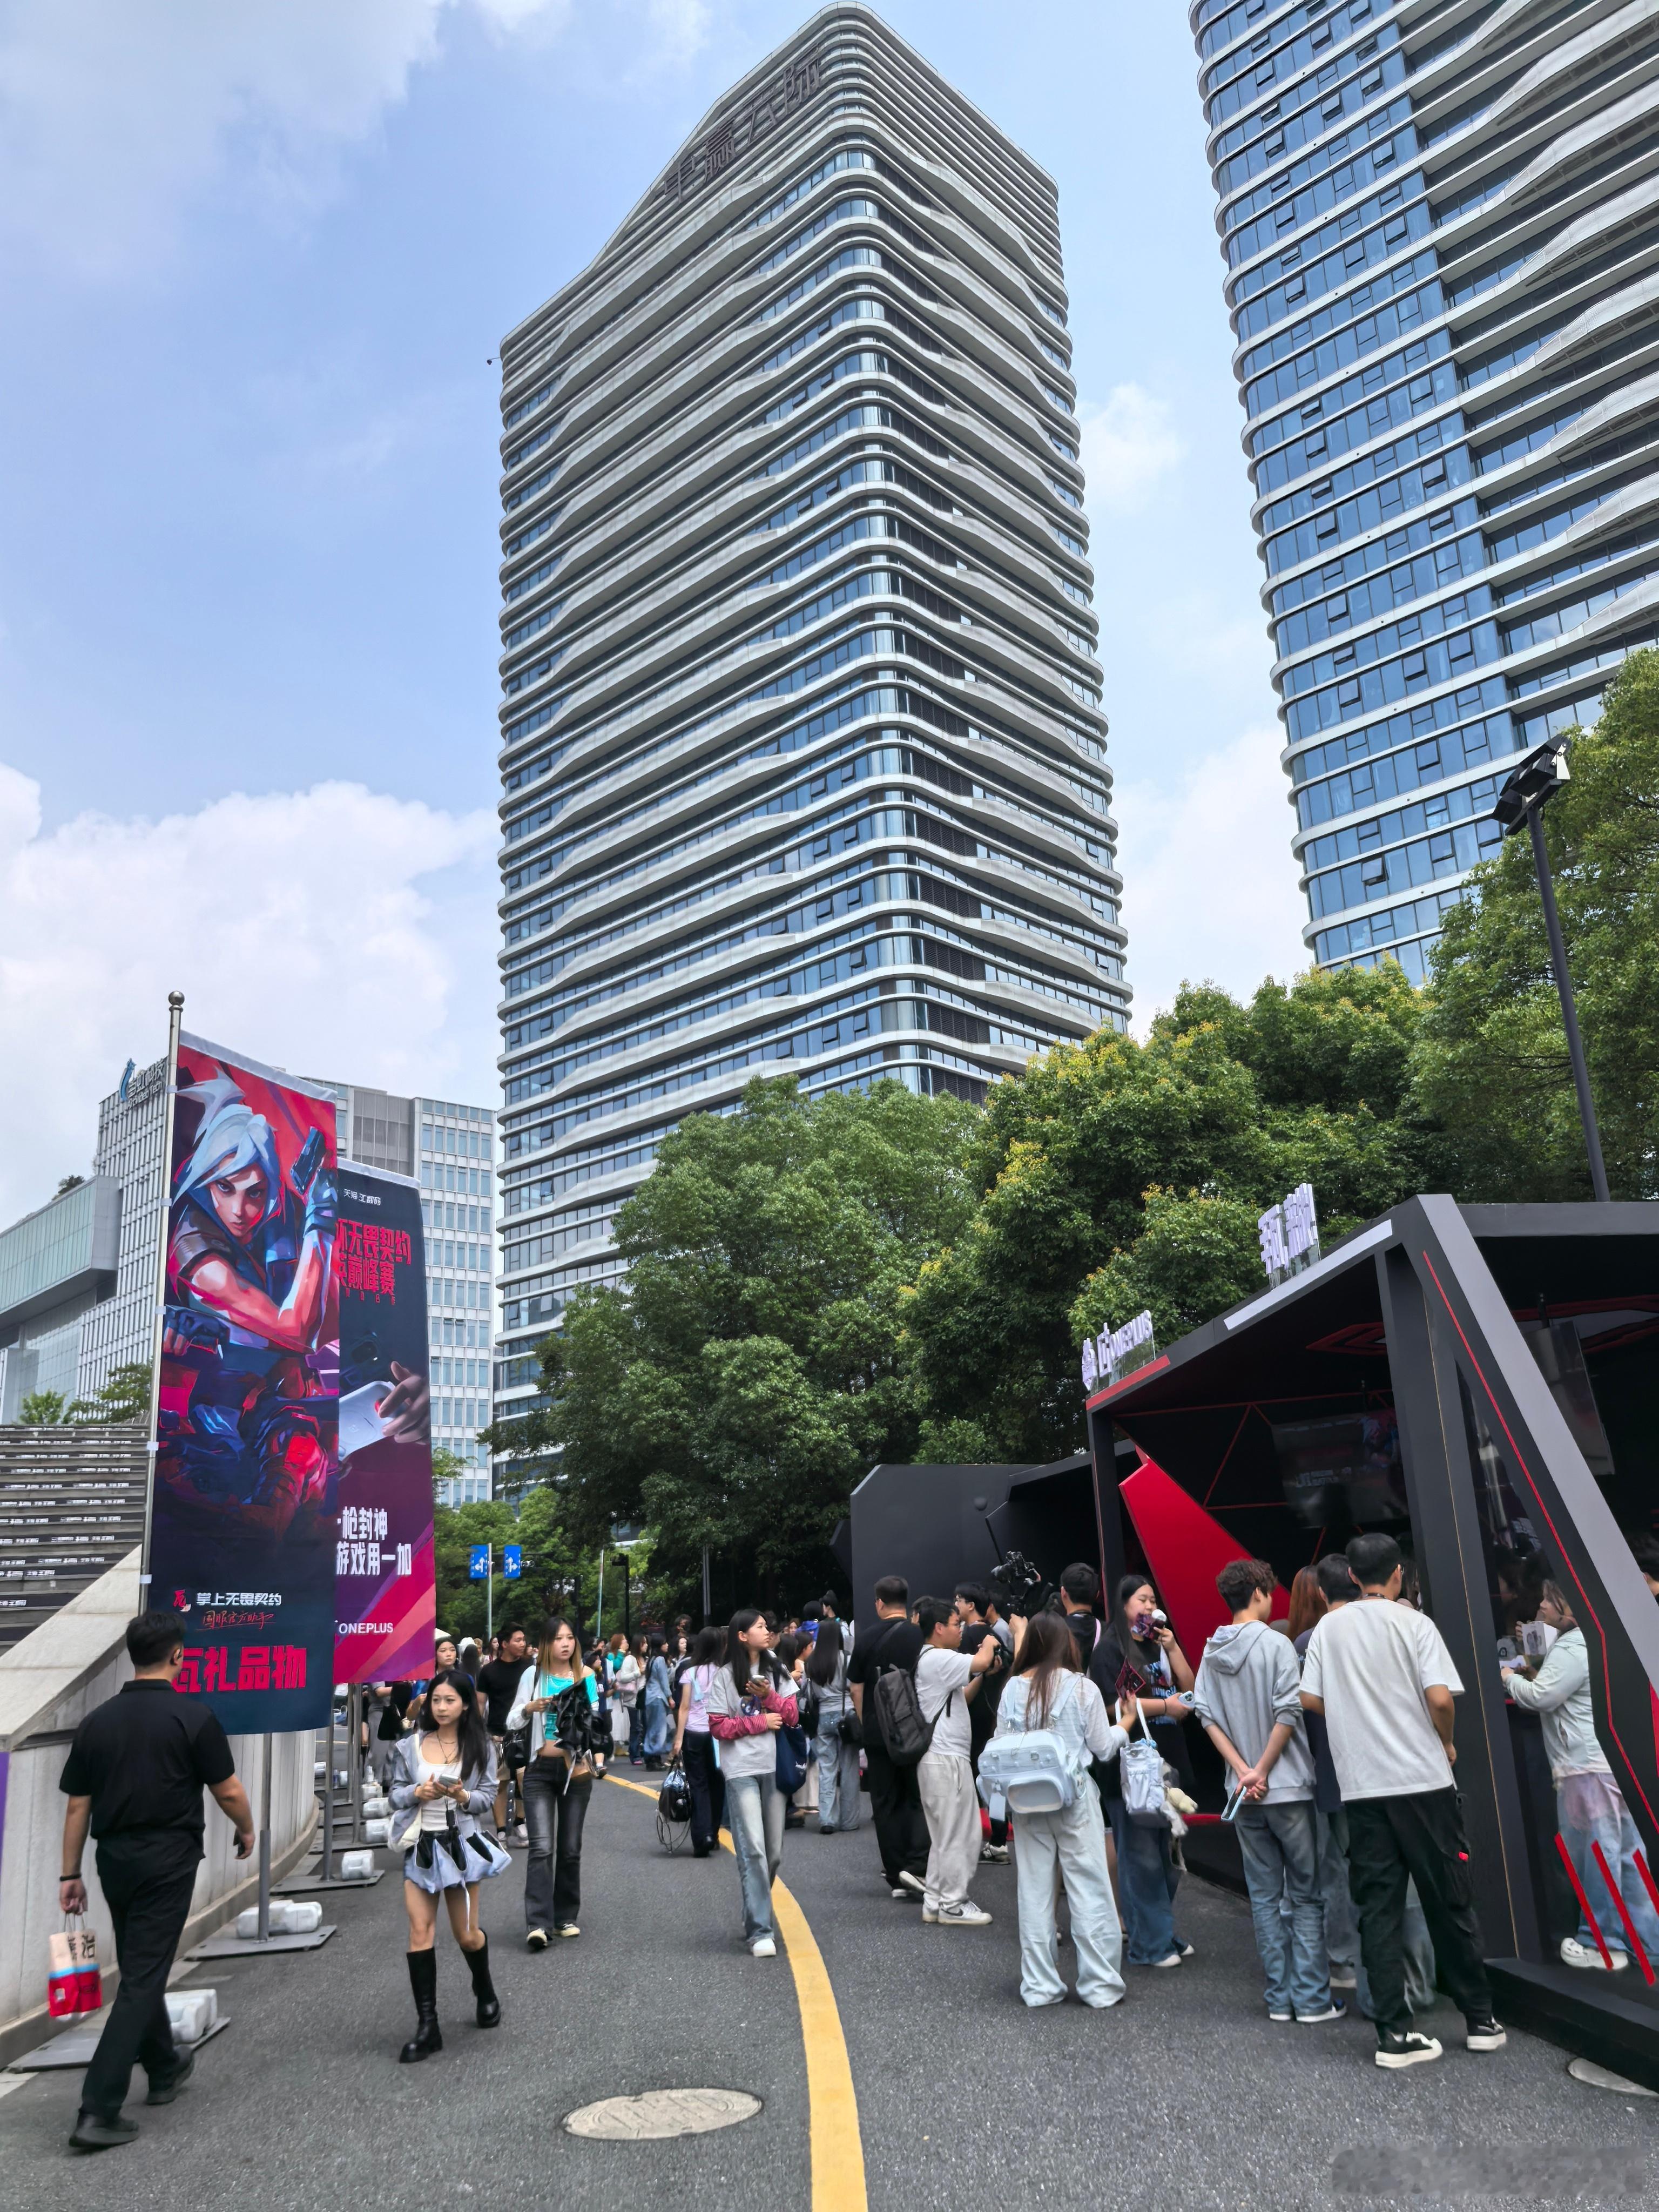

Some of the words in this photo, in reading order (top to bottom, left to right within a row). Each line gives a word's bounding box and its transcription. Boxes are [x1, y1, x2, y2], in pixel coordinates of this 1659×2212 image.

[343, 1189, 358, 1199] 天猫
[337, 1506, 388, 1540] 枪封神
[196, 1592, 282, 1606] 掌上无畏契约
[339, 1622, 394, 1634] ONEPLUS
